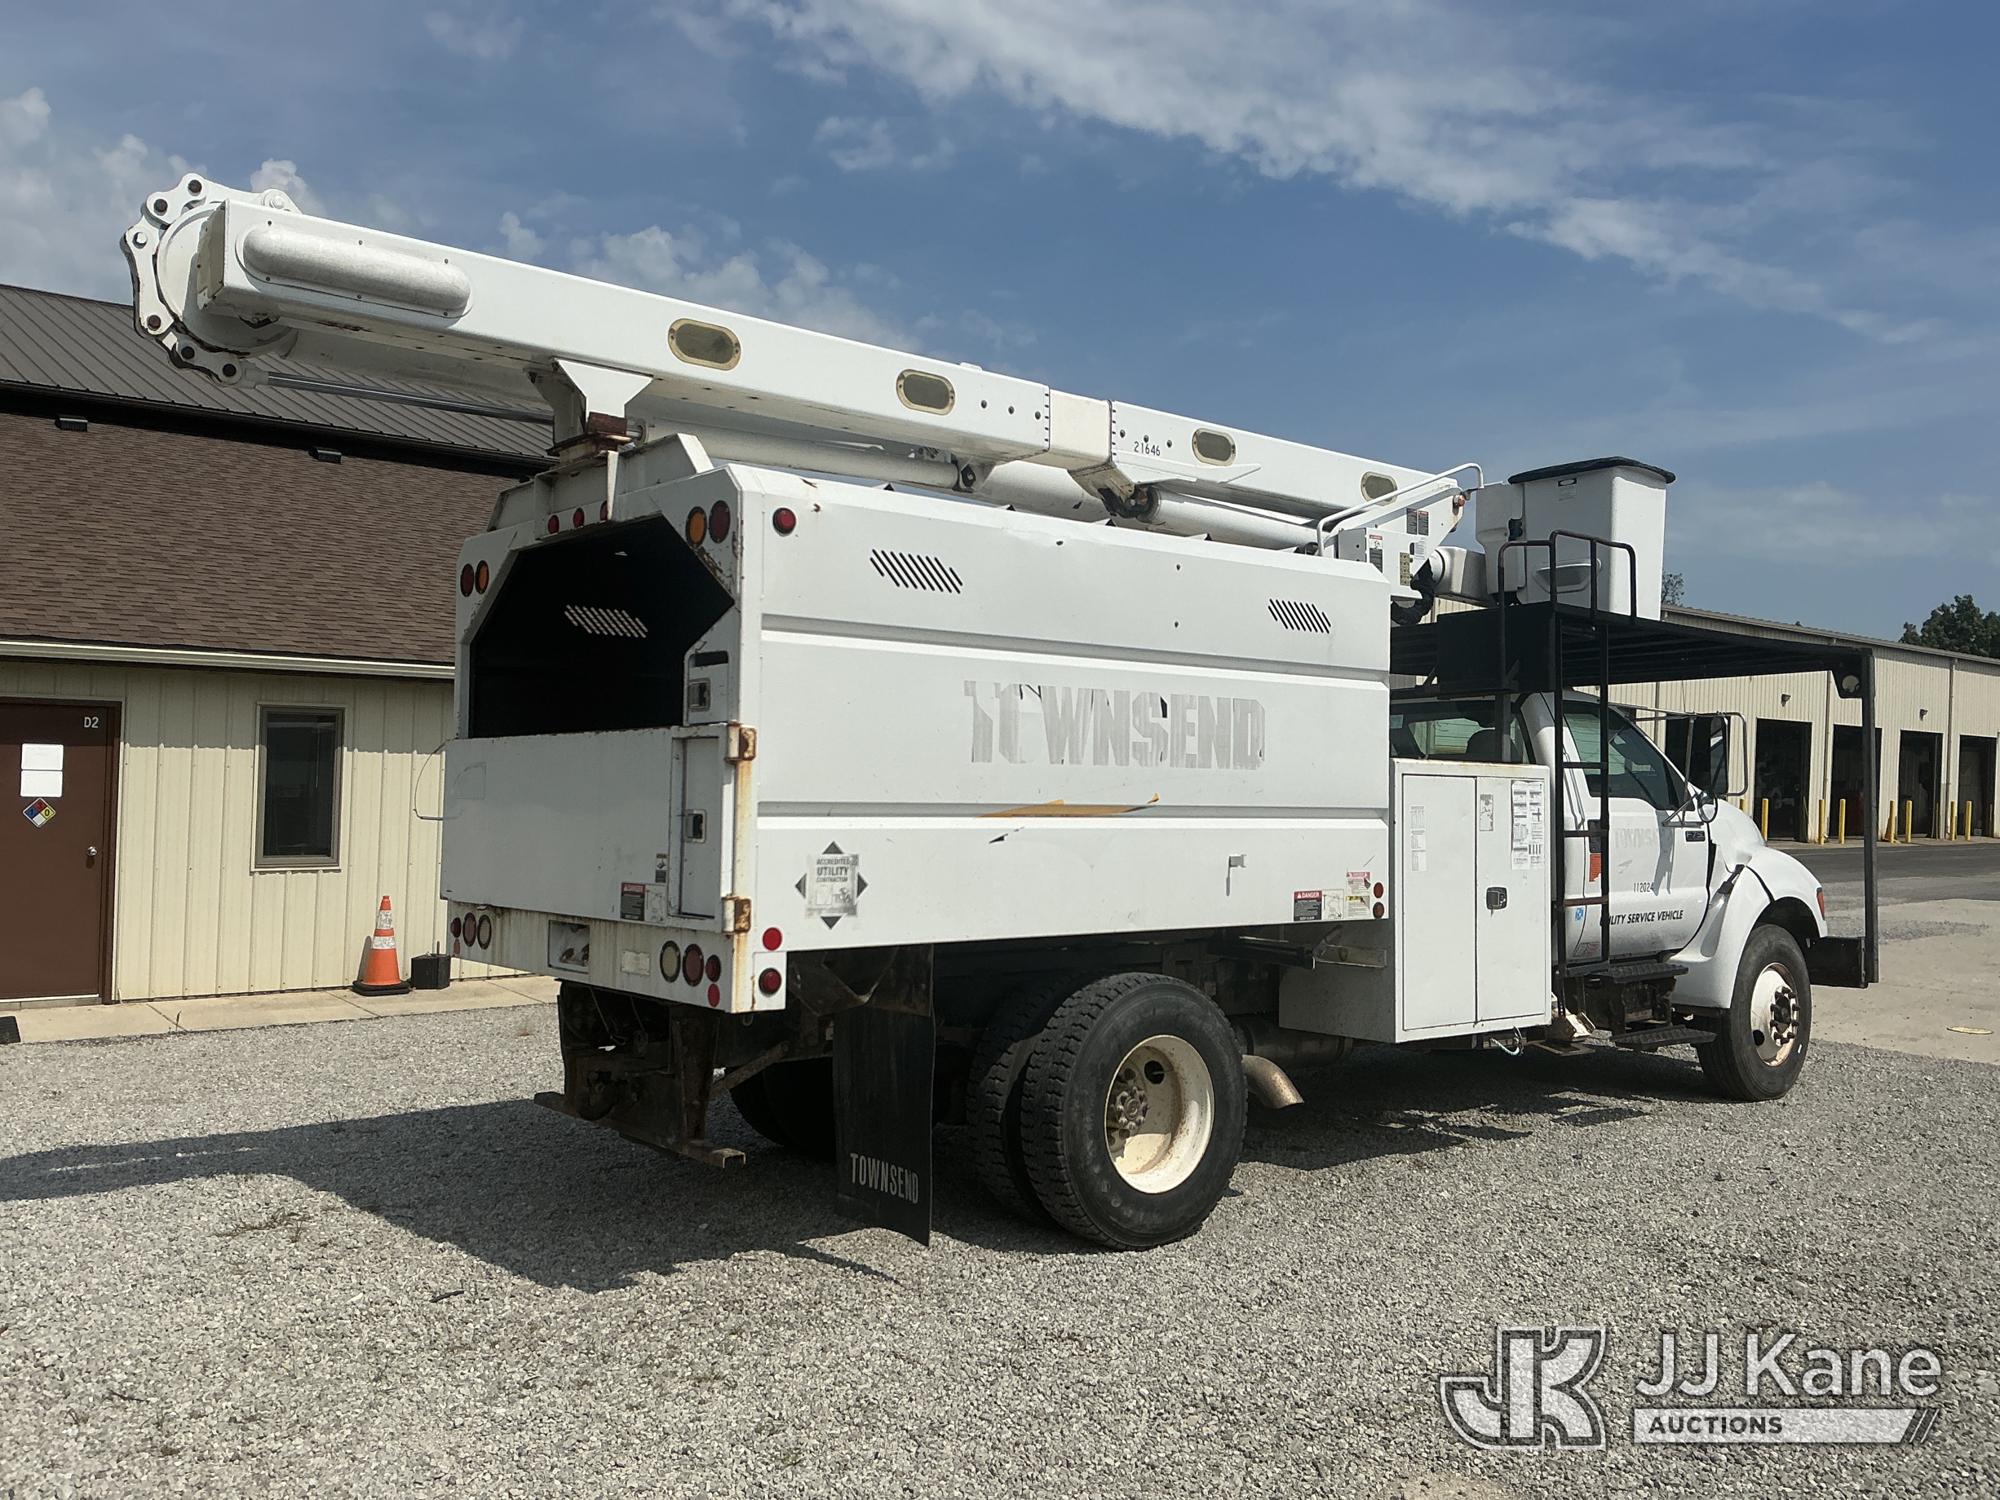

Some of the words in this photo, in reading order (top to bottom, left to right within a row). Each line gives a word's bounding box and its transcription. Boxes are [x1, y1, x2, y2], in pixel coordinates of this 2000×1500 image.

[1133, 441, 1161, 457] 21646
[83, 716, 99, 728] D2
[964, 680, 1265, 770] TOWNSEND
[817, 866, 849, 876] UTILITY
[1627, 911, 1656, 924] SERVICE
[1657, 909, 1684, 921] VEHICLE
[850, 1152, 919, 1204] TOWNSEND
